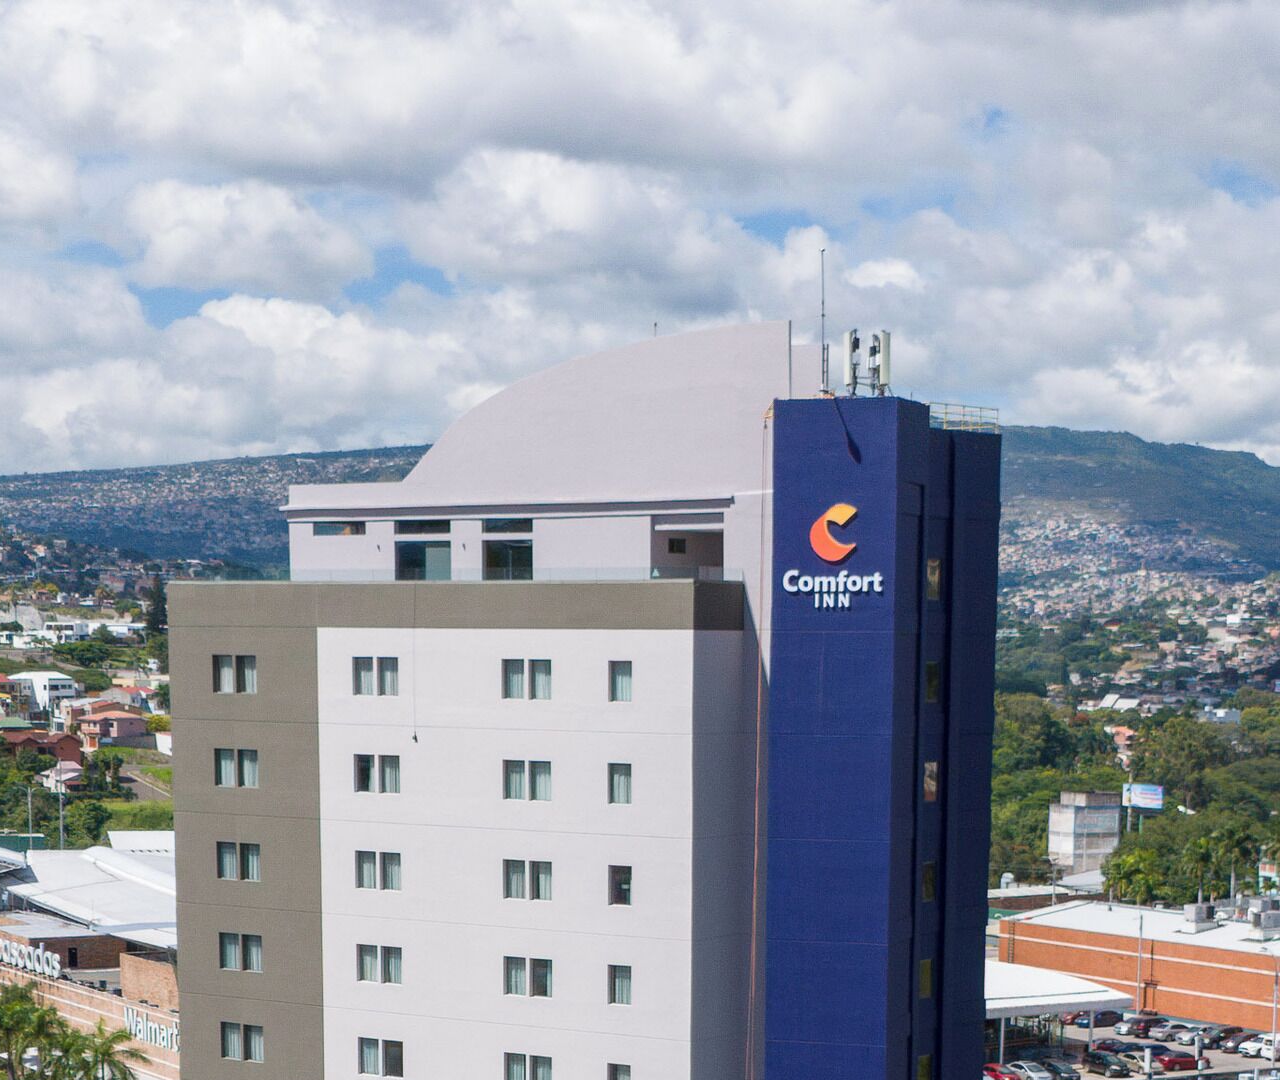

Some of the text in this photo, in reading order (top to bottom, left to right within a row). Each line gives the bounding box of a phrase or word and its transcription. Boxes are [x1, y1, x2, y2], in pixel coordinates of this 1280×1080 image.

[782, 569, 883, 592] Comfort
[814, 593, 850, 608] INN
[123, 1006, 180, 1052] Walmart
